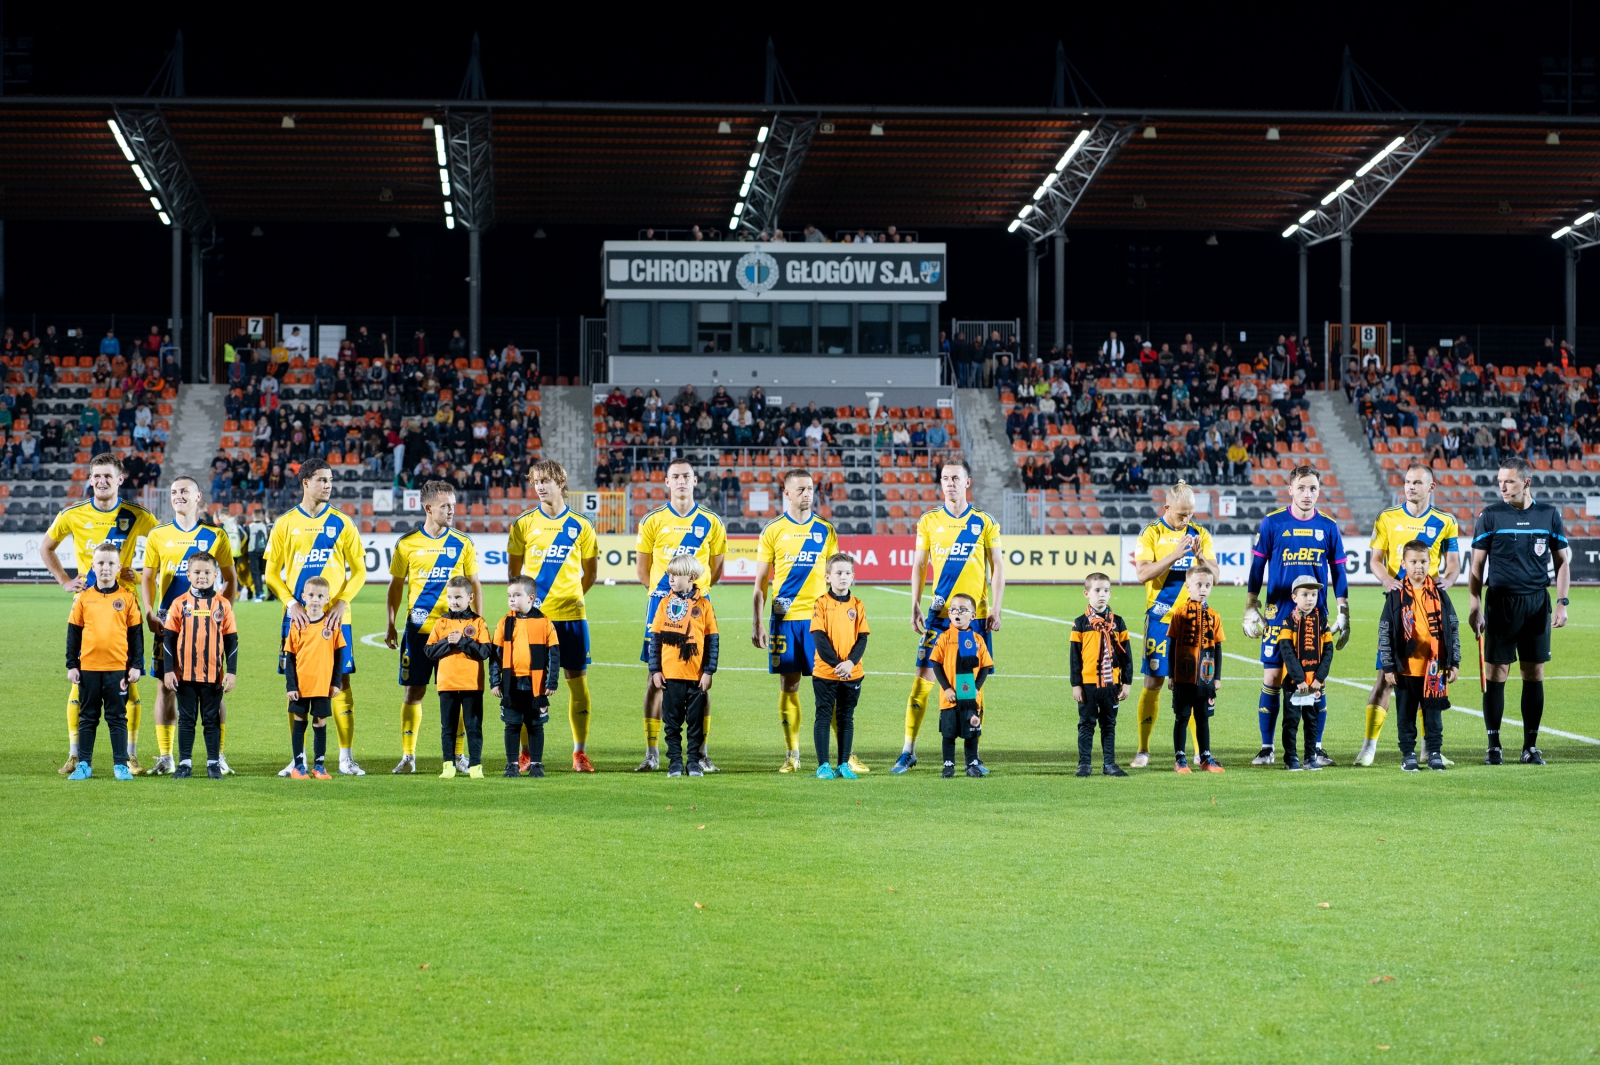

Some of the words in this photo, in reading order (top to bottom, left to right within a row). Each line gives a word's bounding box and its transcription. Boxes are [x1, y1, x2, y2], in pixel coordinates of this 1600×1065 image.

[631, 259, 732, 283] CHROBRY
[786, 256, 876, 284] GŁOGÓW
[880, 260, 919, 284] S.A.
[251, 319, 260, 332] 7
[1364, 328, 1373, 340] 8
[586, 495, 597, 510] 5
[3, 552, 24, 560] sws
[293, 548, 337, 564] forBET
[531, 544, 575, 558] forBET
[934, 542, 979, 556] forBET
[1282, 548, 1325, 562] forBET
[784, 551, 821, 562] forBET
[1002, 550, 1116, 566] ORTUNA
[1174, 556, 1197, 567] BET
[167, 560, 189, 572] forB
[418, 566, 455, 578] forBET
[1262, 625, 1281, 645] 95
[1146, 638, 1167, 658] 94
